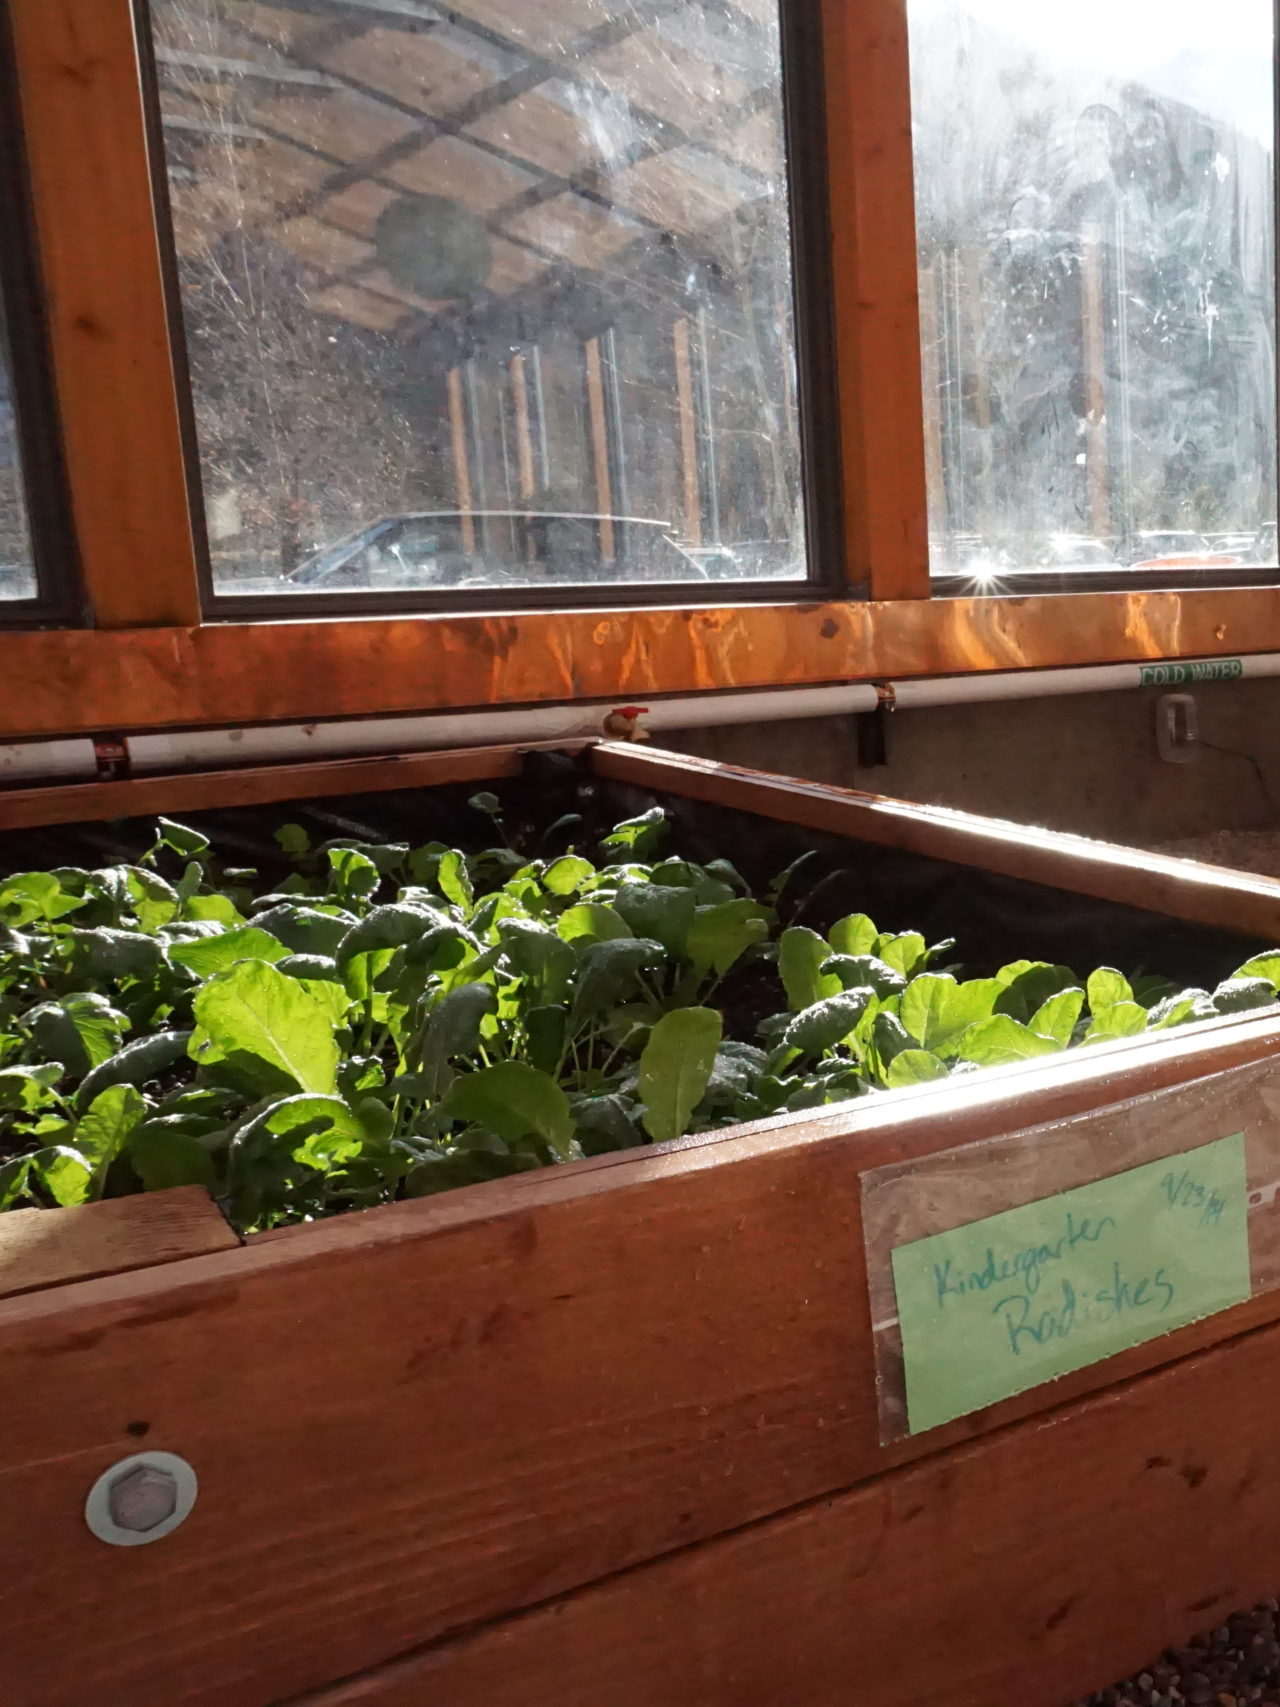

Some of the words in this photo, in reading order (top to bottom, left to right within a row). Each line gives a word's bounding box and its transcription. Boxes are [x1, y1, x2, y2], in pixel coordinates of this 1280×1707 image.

[1142, 664, 1185, 685] COLD
[1191, 661, 1241, 681] WATER
[992, 1262, 1174, 1355] Radishes
